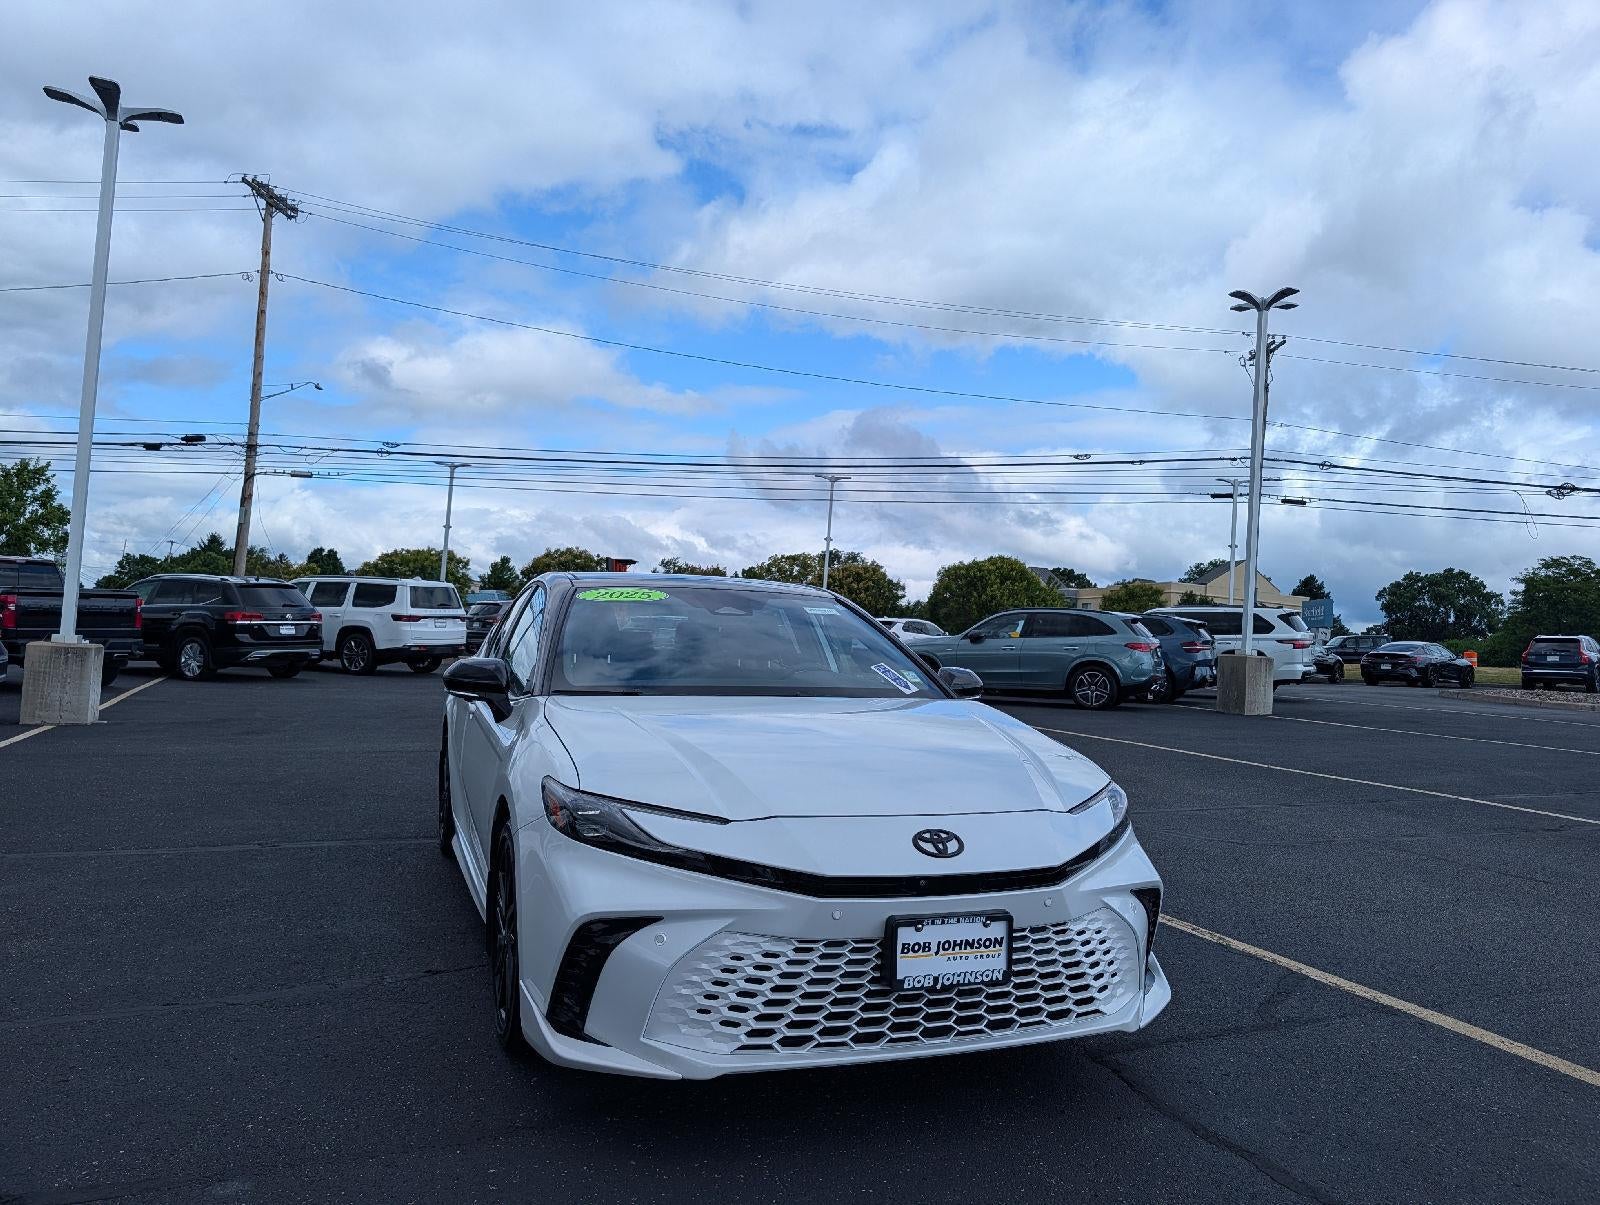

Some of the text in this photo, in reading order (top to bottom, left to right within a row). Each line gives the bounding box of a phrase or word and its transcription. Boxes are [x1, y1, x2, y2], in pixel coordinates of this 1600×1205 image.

[594, 591, 653, 599] 2025
[944, 917, 958, 925] THE
[960, 916, 986, 924] NATION
[900, 936, 1005, 956] BOB JOHNSON
[903, 968, 1003, 989] BOB JOHNSON
